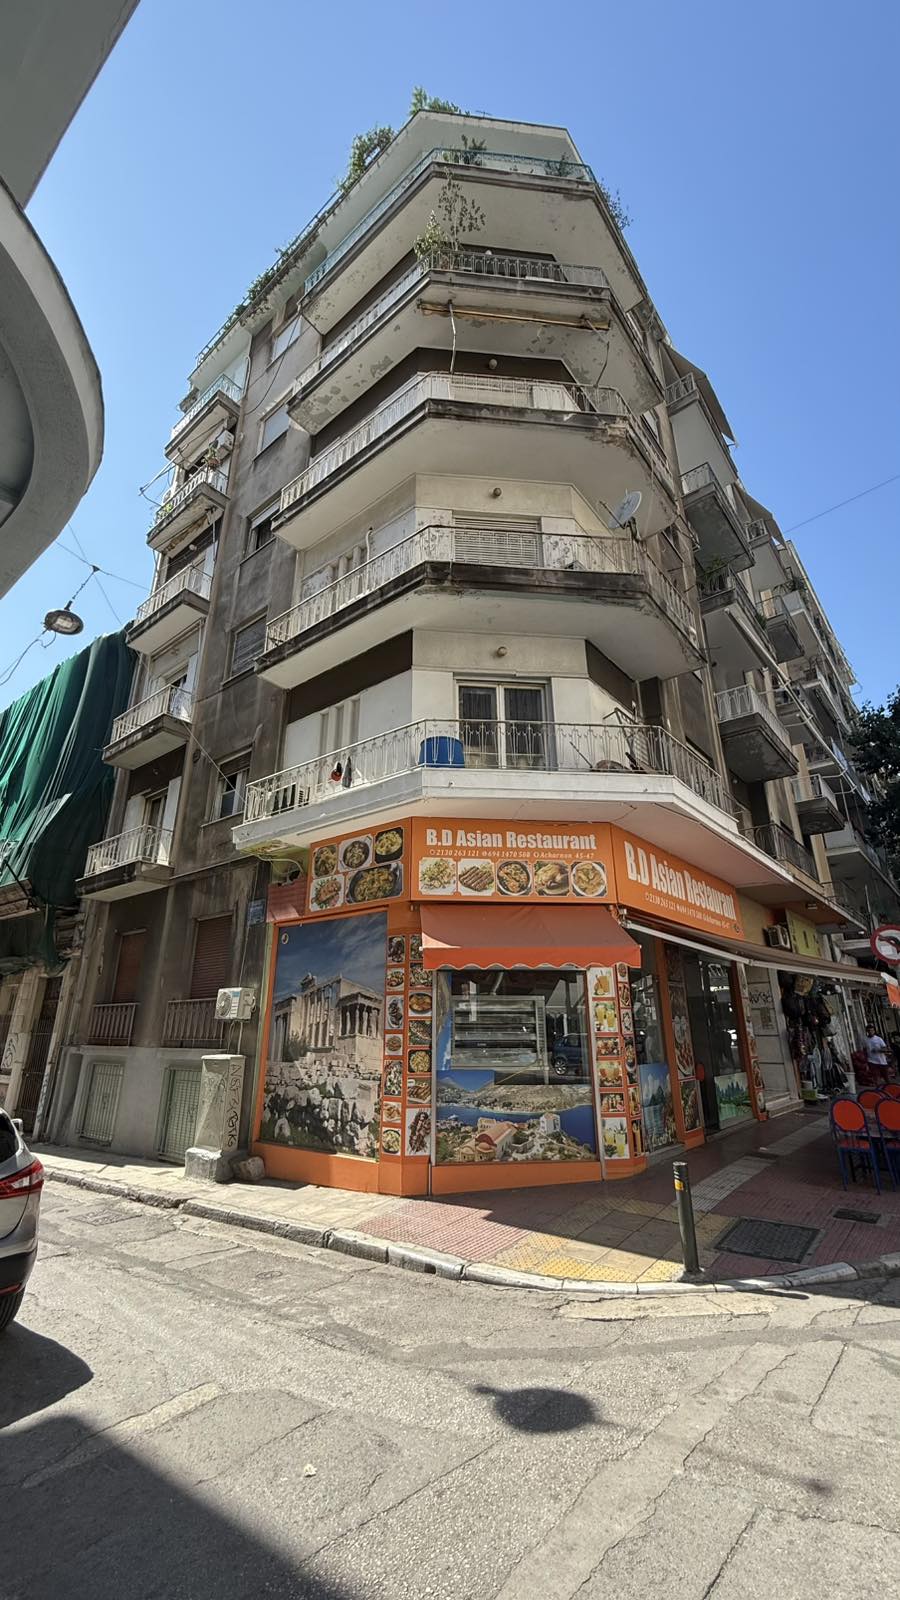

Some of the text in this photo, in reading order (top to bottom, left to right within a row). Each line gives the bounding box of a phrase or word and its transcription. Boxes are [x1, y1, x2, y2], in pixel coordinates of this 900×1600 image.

[426, 828, 597, 850] B.D Asian Restaurant
[624, 841, 649, 886] B.D
[650, 853, 686, 900] Asian
[684, 870, 736, 920] Restaurant
